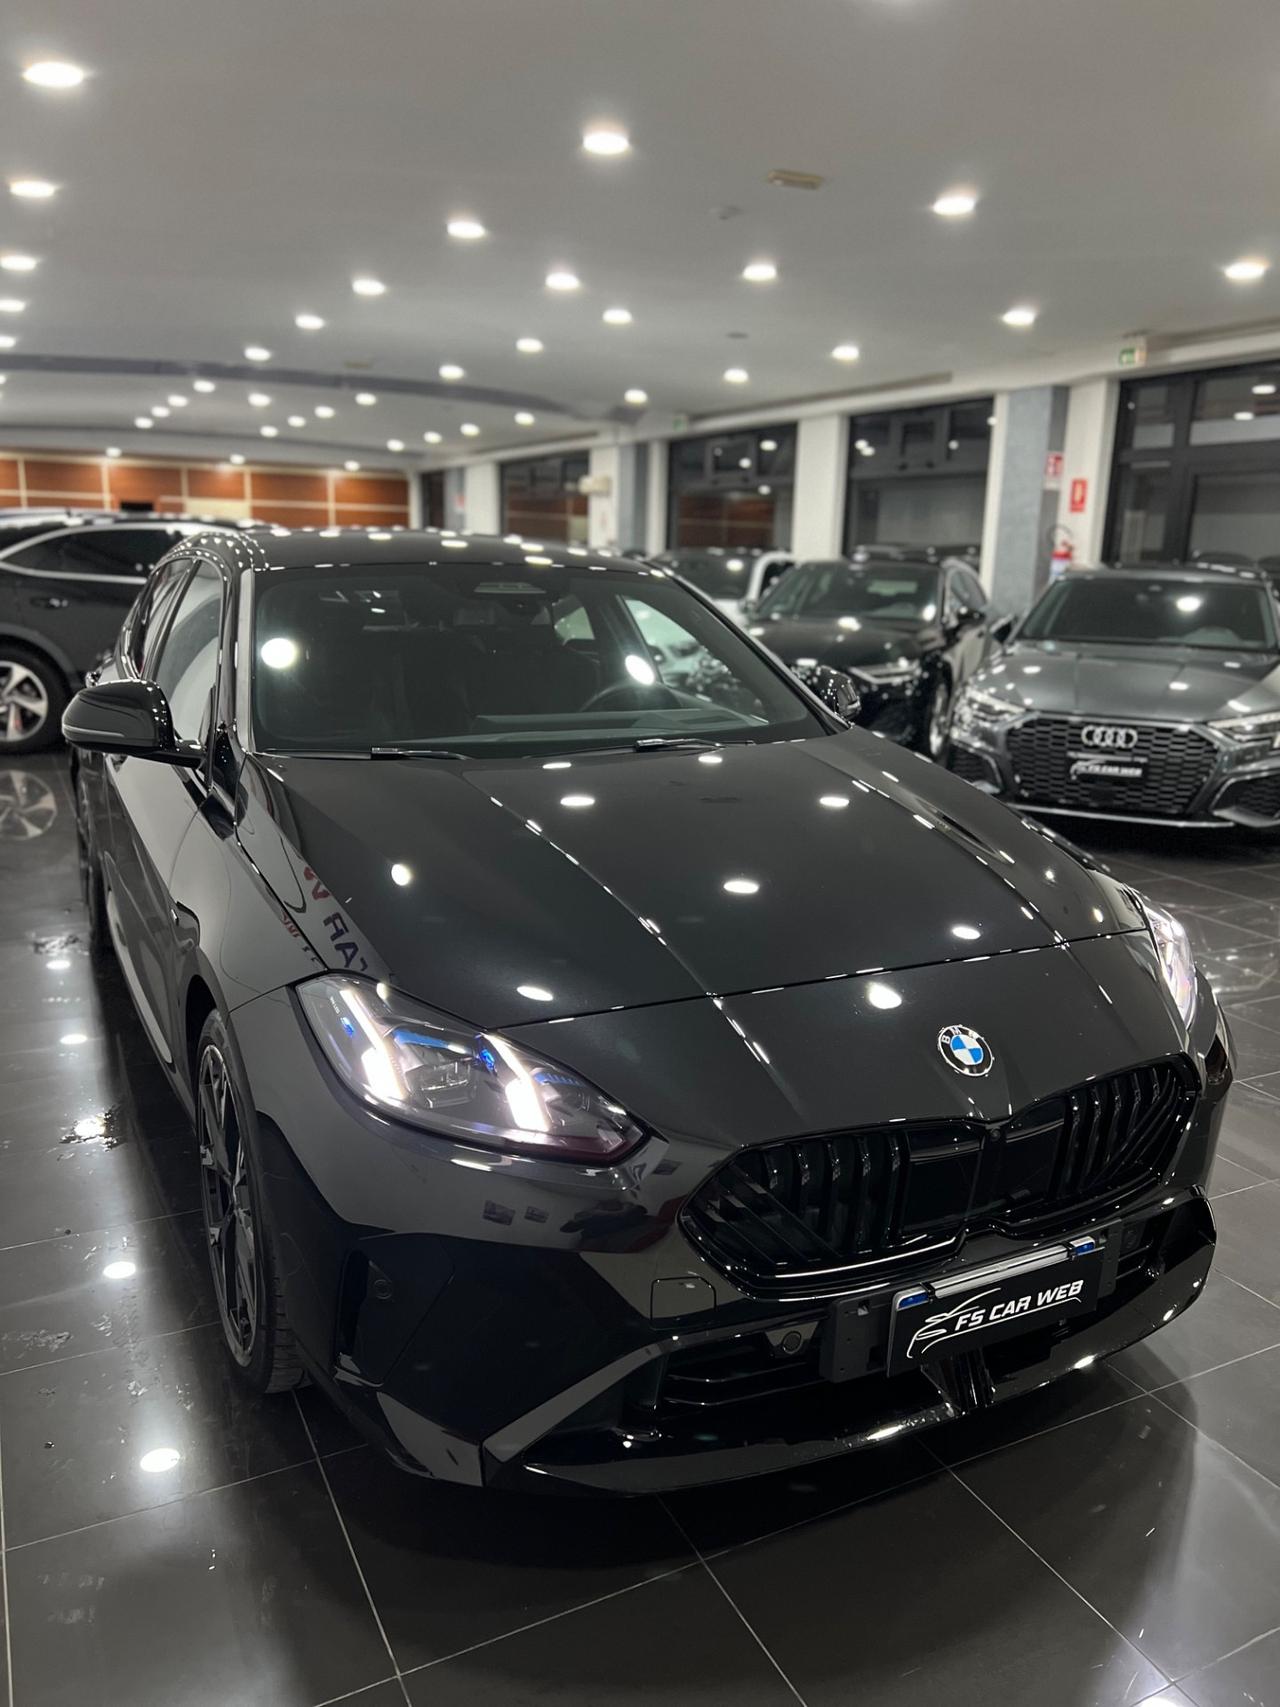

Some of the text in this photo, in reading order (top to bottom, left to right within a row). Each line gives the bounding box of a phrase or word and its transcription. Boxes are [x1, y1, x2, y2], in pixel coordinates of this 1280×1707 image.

[941, 1026, 979, 1045] BMW
[955, 1279, 1084, 1331] FS CAR WEB
